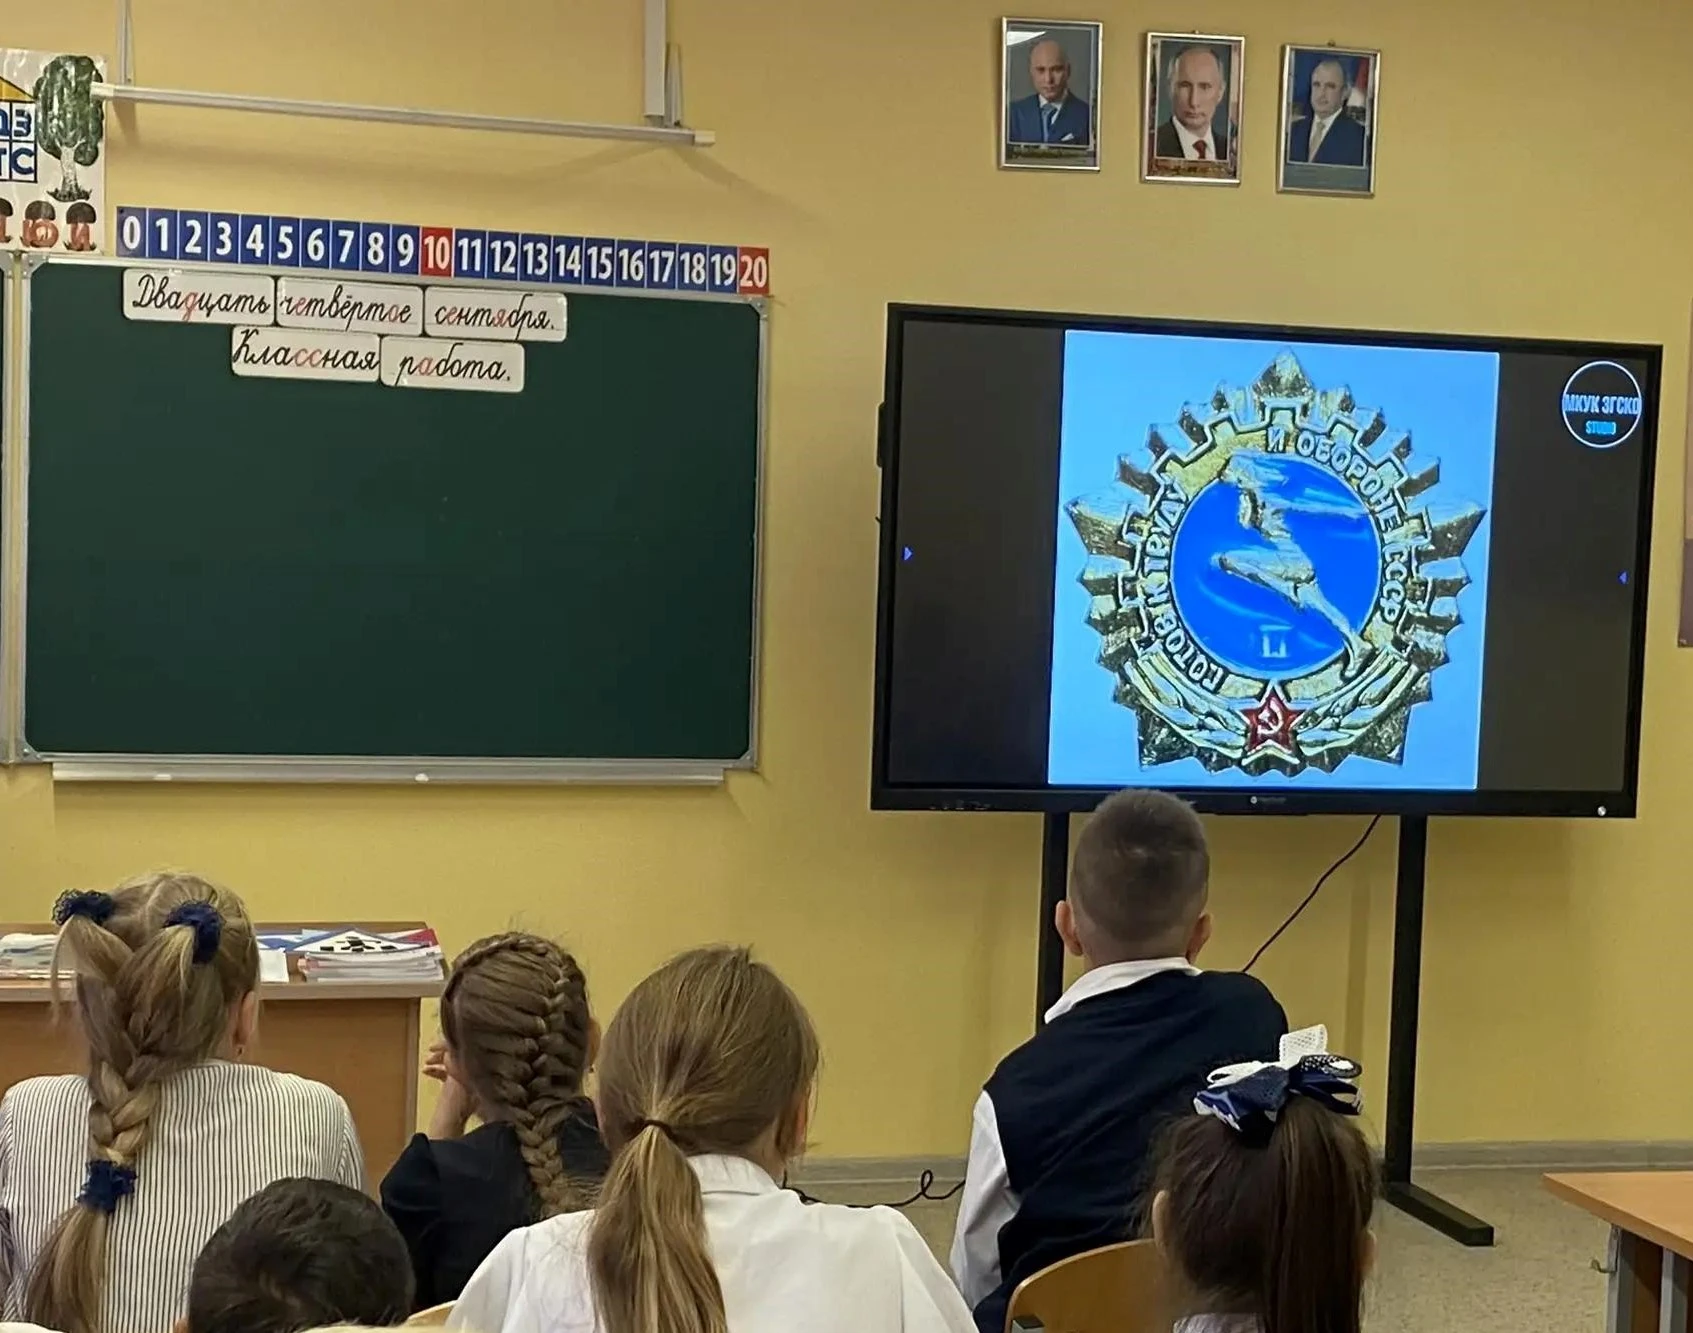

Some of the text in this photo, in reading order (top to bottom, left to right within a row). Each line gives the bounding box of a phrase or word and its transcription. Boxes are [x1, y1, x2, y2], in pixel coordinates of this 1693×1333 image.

[122, 215, 768, 288] 0 1 2 3 4 5 6 7 8 9 10 11 12 13 14 15 16 17 18 19 20
[132, 273, 555, 341] Двадцать четвёртое сентября.
[231, 328, 511, 387] Классная работа.
[1267, 426, 1285, 453] И
[1296, 430, 1404, 533] ОБОРОНЕ
[1145, 575, 1170, 604] К
[1380, 543, 1410, 623] СССР
[1153, 610, 1224, 693] ГОТОВ
